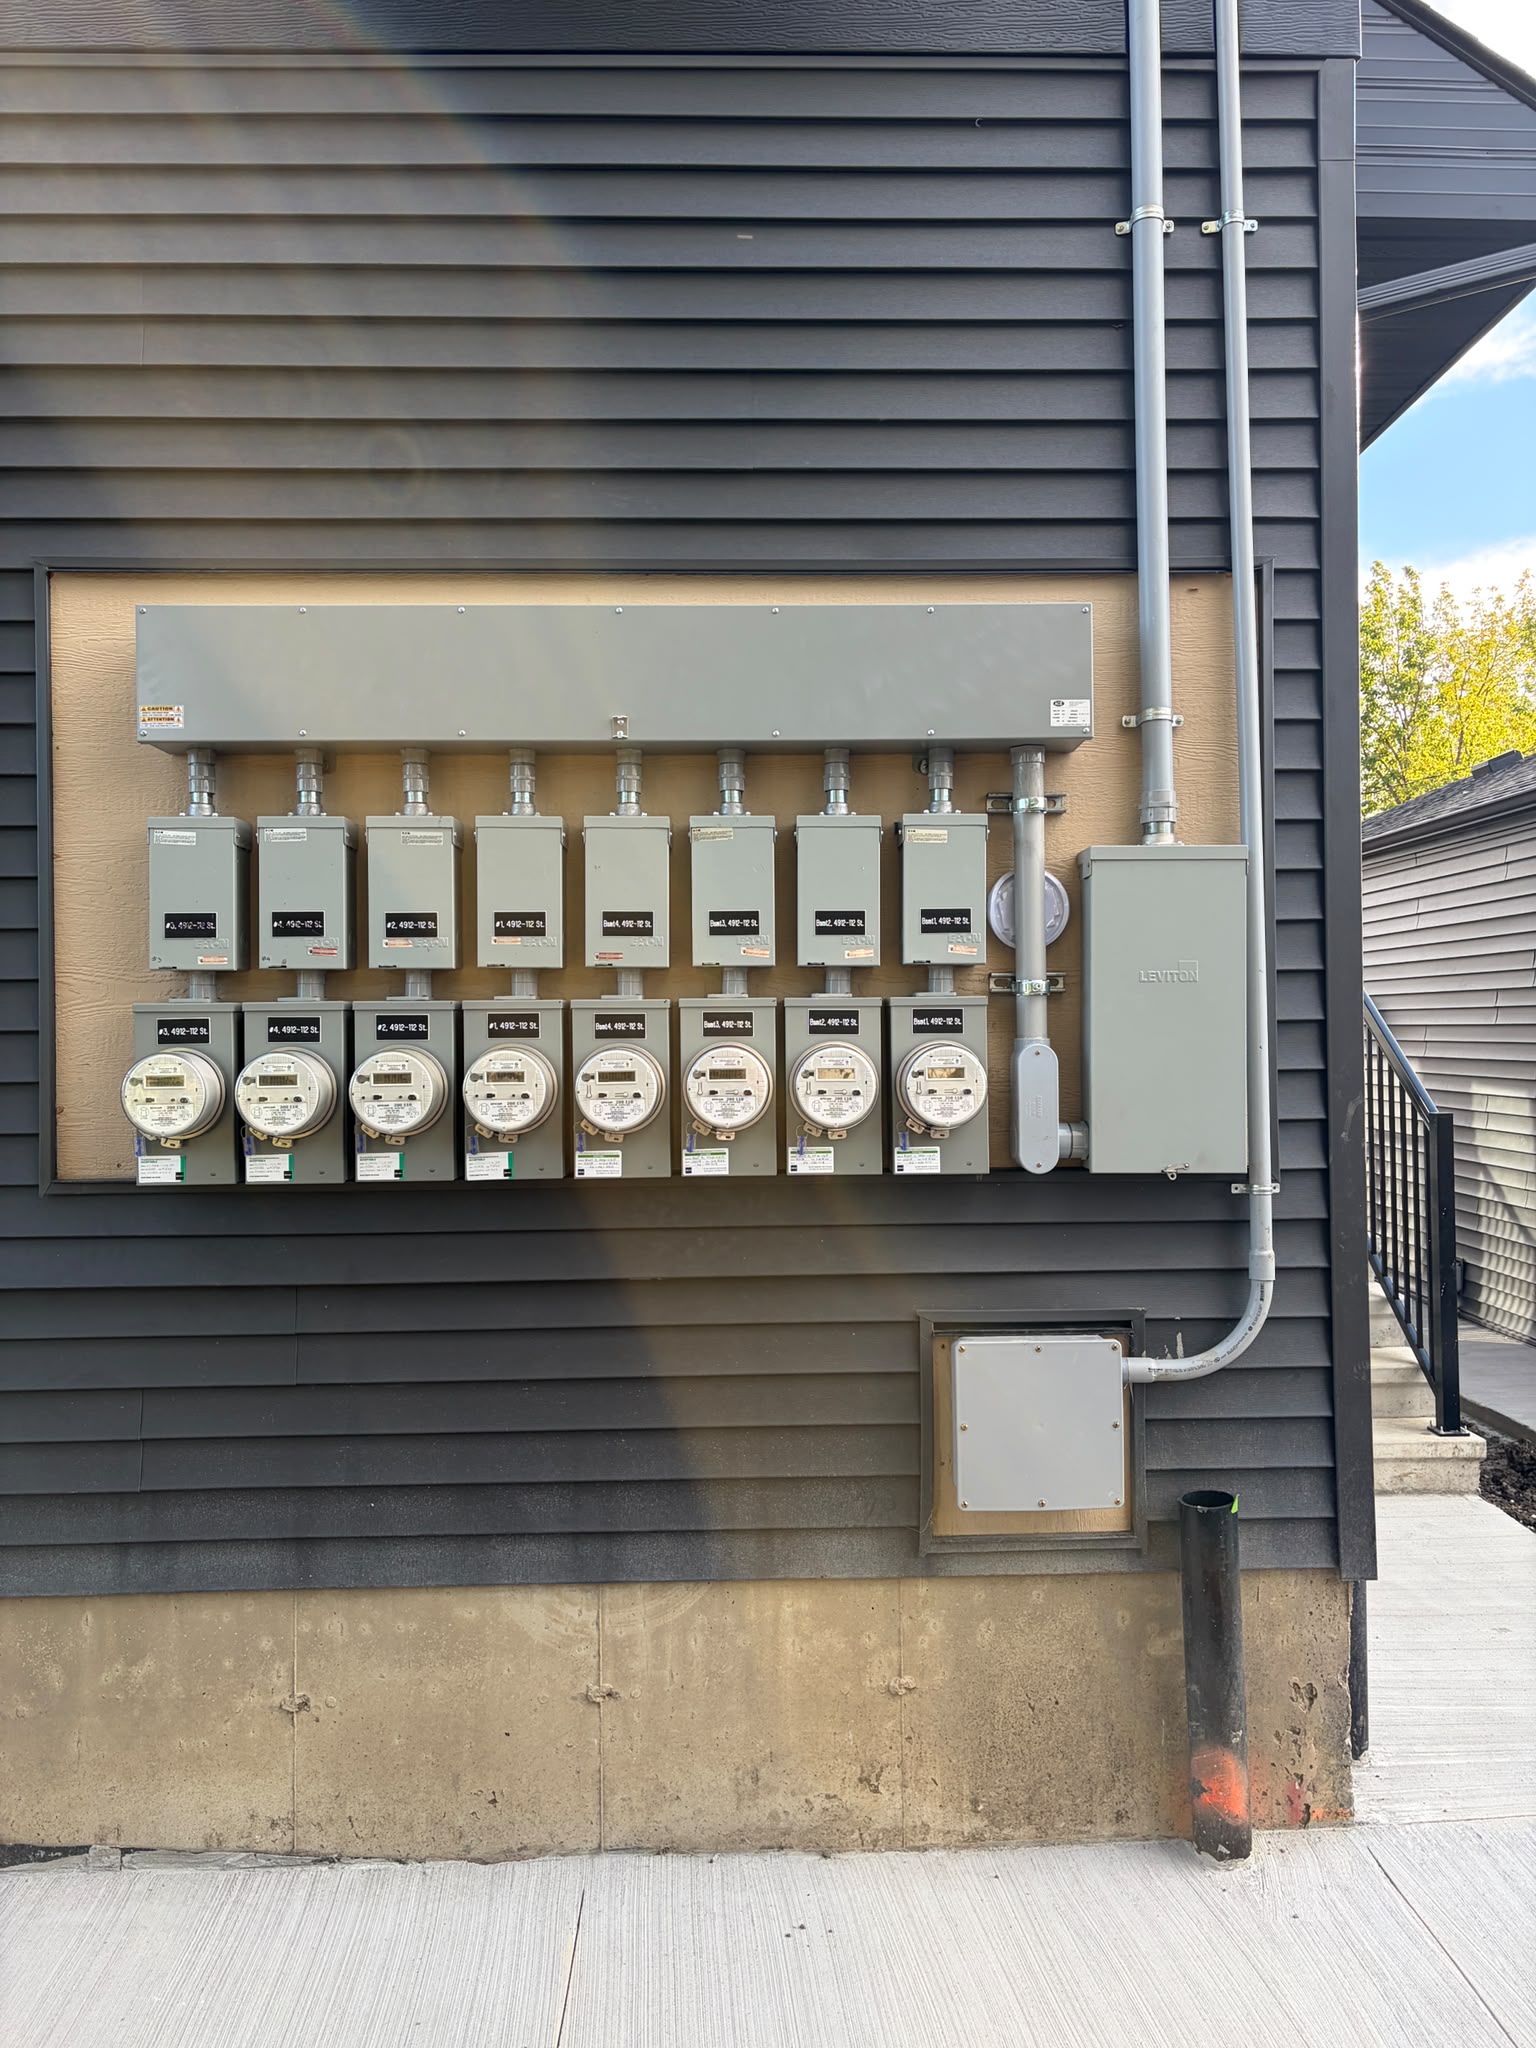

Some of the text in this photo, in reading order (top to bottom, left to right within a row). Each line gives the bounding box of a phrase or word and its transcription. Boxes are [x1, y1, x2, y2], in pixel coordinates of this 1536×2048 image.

[399, 920, 426, 930] 4912-112
[505, 920, 534, 929] 4912-112
[621, 919, 644, 928] 4912-112
[727, 919, 750, 928] 4912-112
[833, 918, 856, 928] 4912-112
[938, 917, 961, 925] 4912-112
[1139, 970, 1199, 983] LEVITON
[499, 1022, 528, 1030] 4912-112
[721, 1020, 744, 1029] 4912-112
[826, 1018, 850, 1027] 4912-112
[929, 1017, 953, 1026] 4912-112
[281, 1026, 309, 1034] 4912-112
[389, 1024, 417, 1032] 4912-112
[613, 1022, 636, 1031] 4912-112
[171, 1027, 198, 1036] 4912-112
